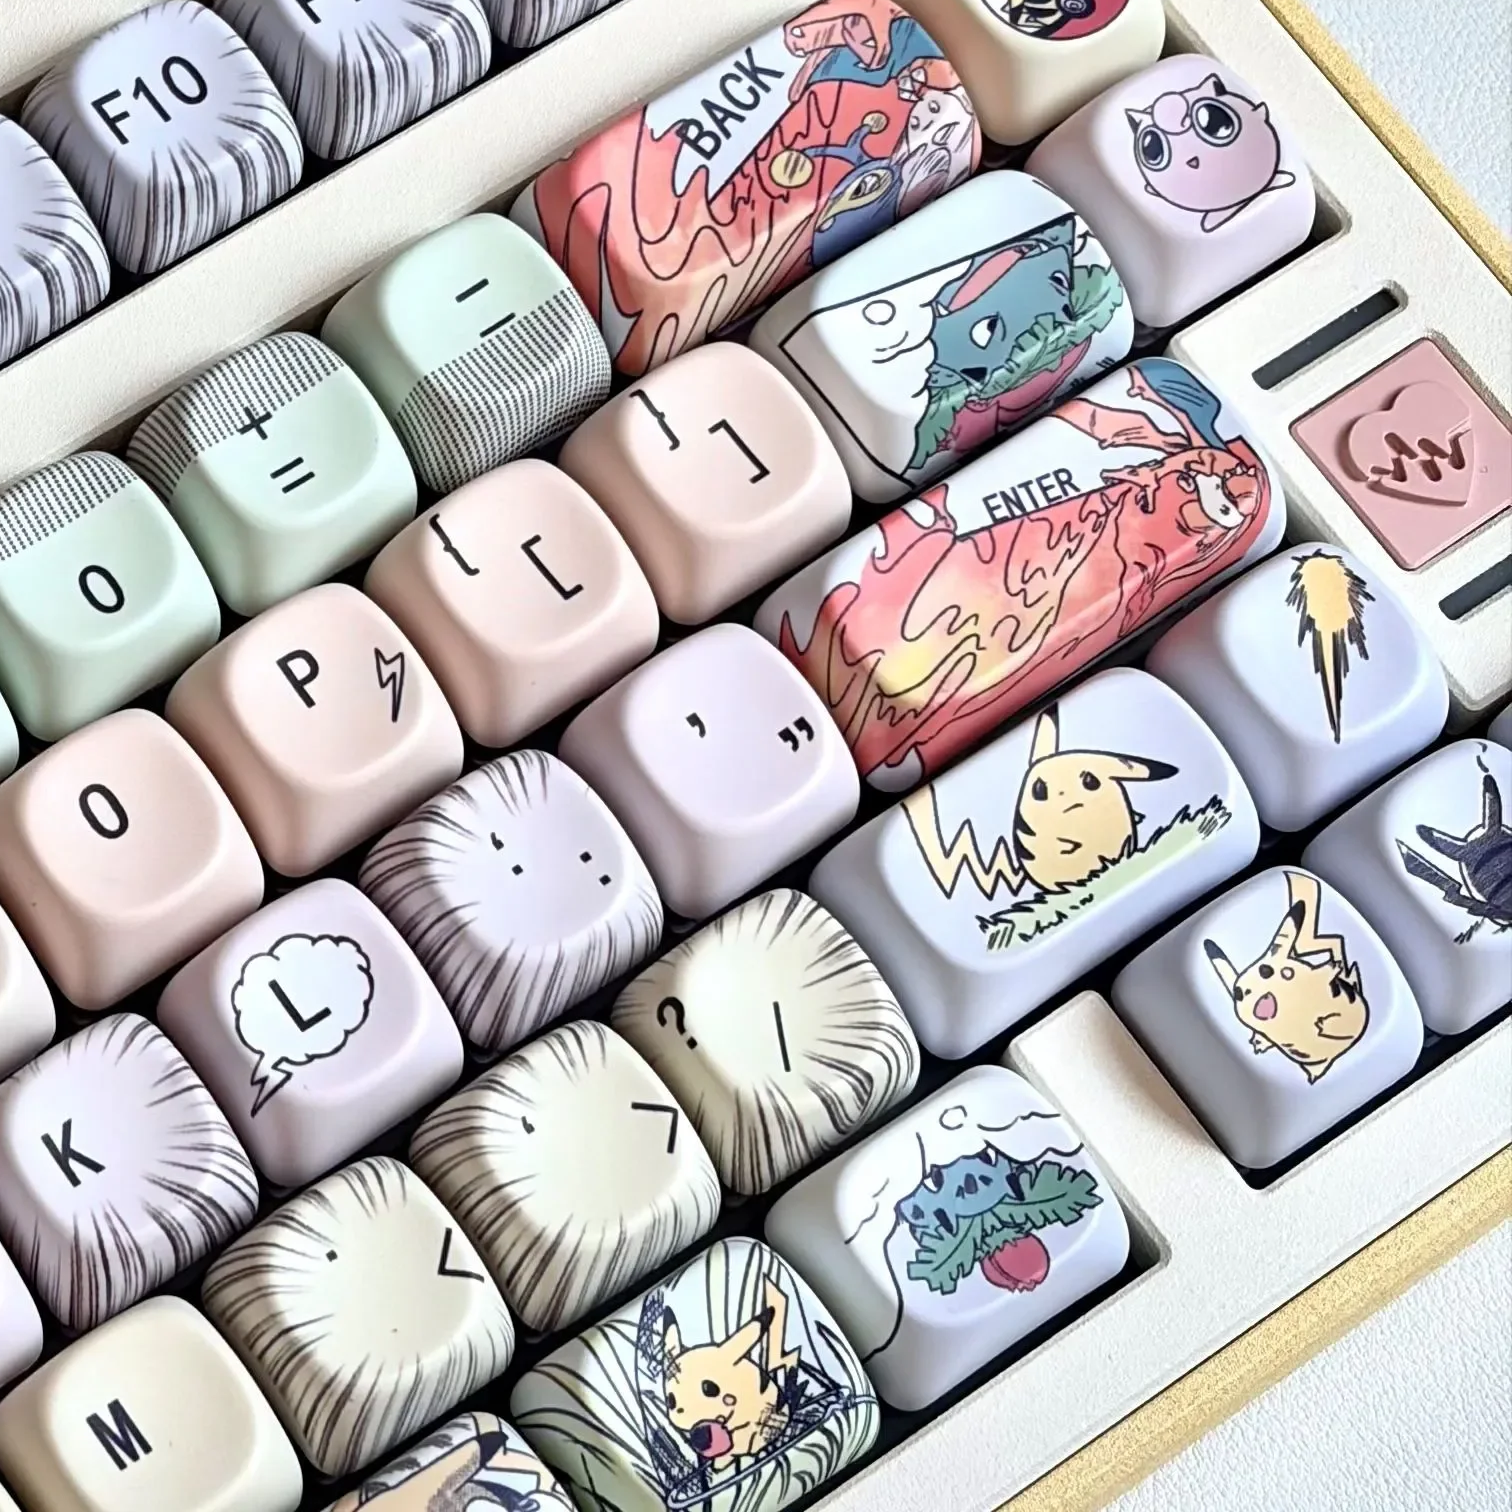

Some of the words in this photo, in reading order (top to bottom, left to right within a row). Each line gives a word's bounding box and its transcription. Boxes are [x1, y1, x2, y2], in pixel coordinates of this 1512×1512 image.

[91, 56, 208, 145] F10
[674, 46, 785, 162] BACK
[981, 467, 1082, 524] ENTER
[276, 649, 320, 708] P
[268, 979, 332, 1033] L
[41, 1119, 105, 1188] K
[86, 1399, 153, 1471] M
